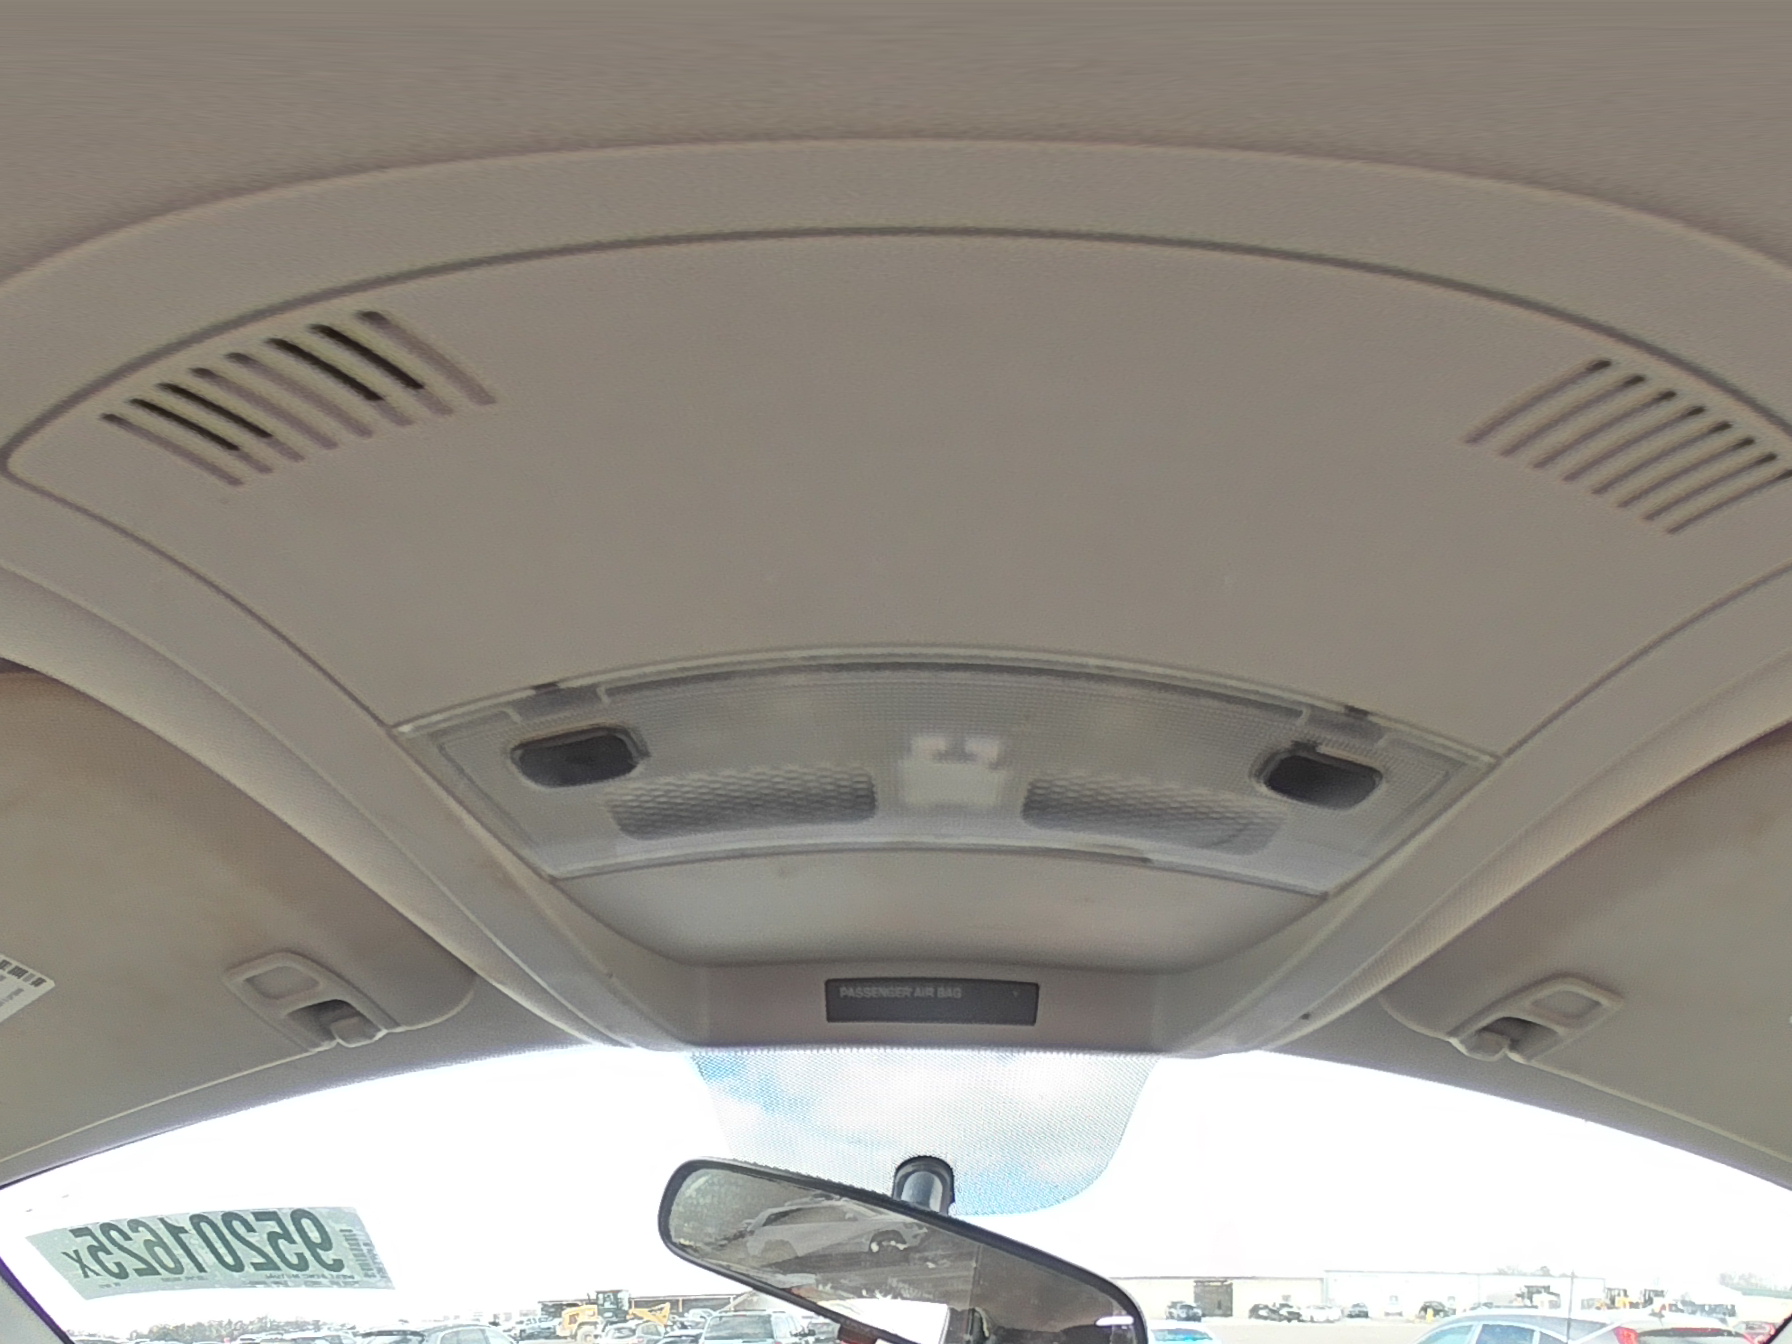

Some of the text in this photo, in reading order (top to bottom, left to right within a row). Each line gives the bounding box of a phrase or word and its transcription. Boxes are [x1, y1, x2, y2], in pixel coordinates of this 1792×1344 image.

[839, 985, 962, 999] PASSENGER AIR BAG
